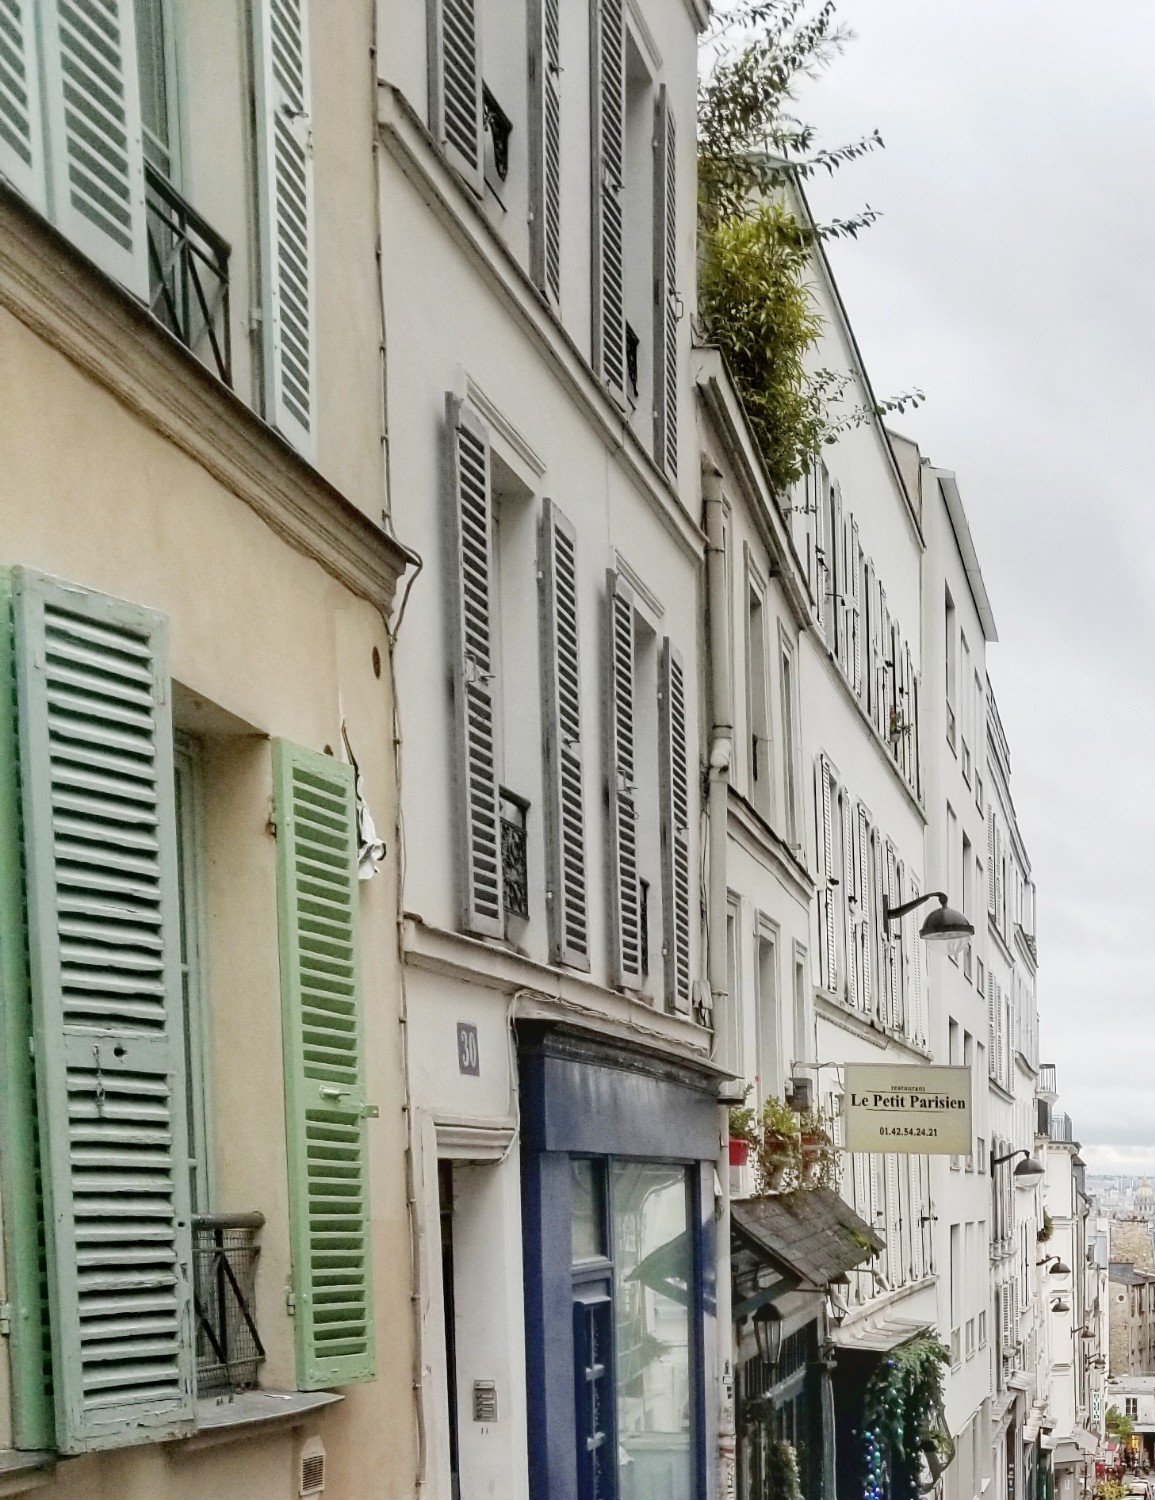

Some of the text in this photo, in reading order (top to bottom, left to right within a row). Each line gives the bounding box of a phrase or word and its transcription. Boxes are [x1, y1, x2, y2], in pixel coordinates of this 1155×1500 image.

[461, 1031, 477, 1067] 30
[851, 1094, 966, 1109] Le Petit Parisien
[879, 1127, 938, 1137] 01.42.54.24.21
